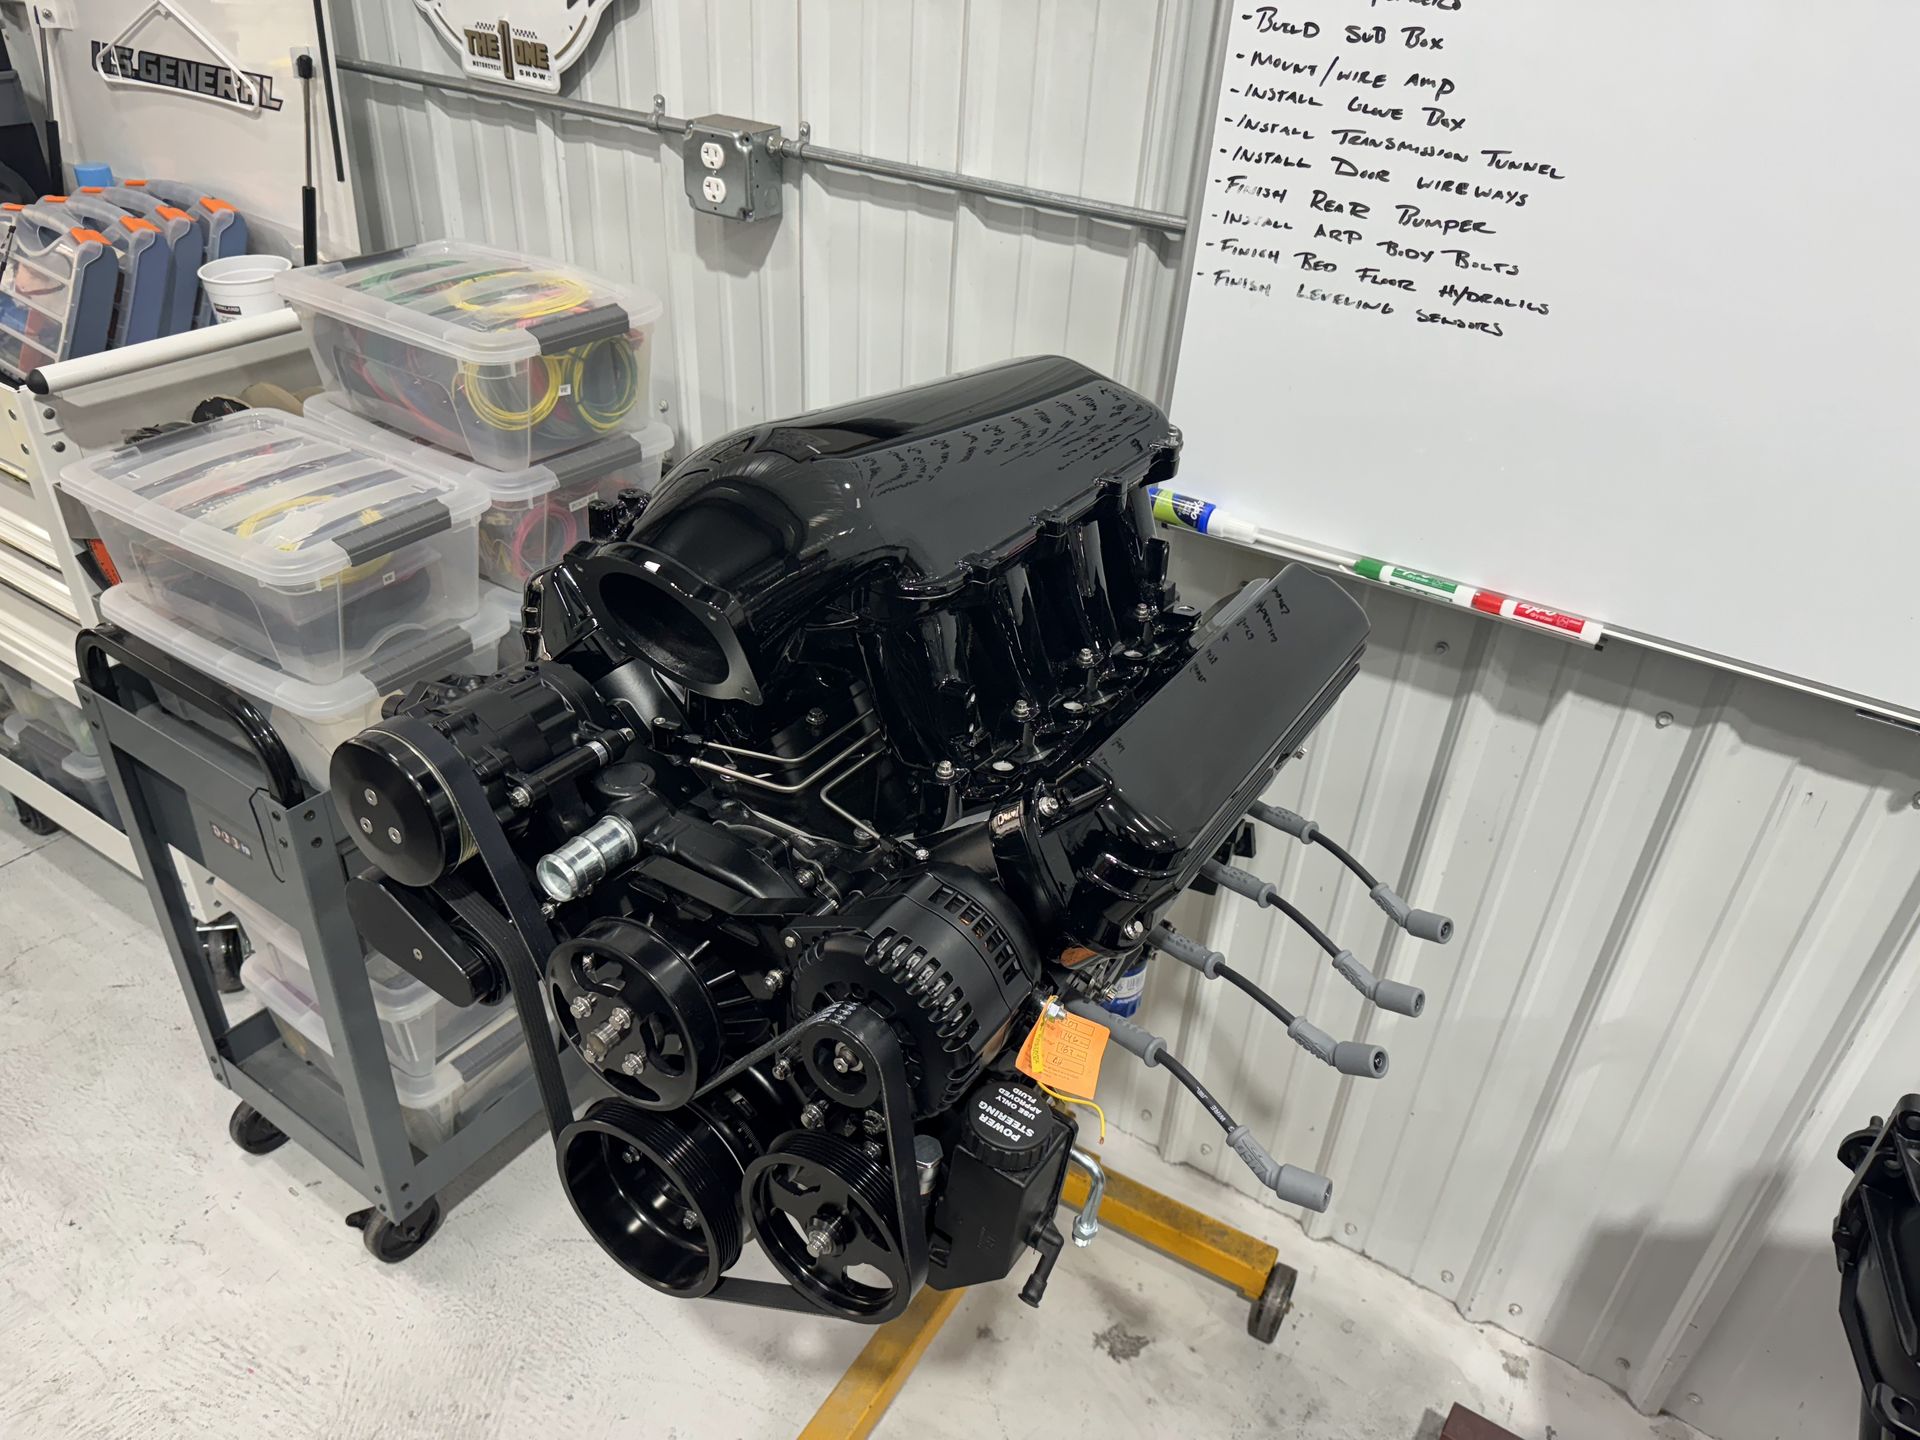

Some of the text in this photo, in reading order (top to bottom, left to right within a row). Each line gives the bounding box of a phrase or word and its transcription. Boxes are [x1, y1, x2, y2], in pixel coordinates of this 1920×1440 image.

[464, 28, 500, 60] THE
[513, 37, 549, 71] ONE
[1344, 25, 1386, 44] SUB
[519, 69, 546, 80] SHOW
[1404, 72, 1455, 101] AMP
[1244, 84, 1324, 107] INSTALL
[1347, 96, 1404, 120] GLOVE
[1232, 145, 1312, 169] INSTALL
[1330, 156, 1390, 183] DOOR
[1236, 114, 1566, 180] INSTALL TRANSMISSION TUNNEL
[1224, 175, 1497, 235] FINISH REAR BUMPER
[1223, 210, 1519, 276] INSTALL ARP BODY BOLTS
[1220, 238, 1280, 264] FINISH
[1293, 252, 1337, 272] BED
[1355, 268, 1417, 292] FLOOR
[1213, 269, 1272, 296] FINISH
[1296, 283, 1394, 315] LEVELING
[995, 1095, 1036, 1120] USE ONLY
[998, 1087, 1042, 1114] APPROVED
[1012, 1087, 1037, 1104] FLUID
[978, 1100, 1035, 1137] STEERING
[979, 1113, 1021, 1142] POWER
